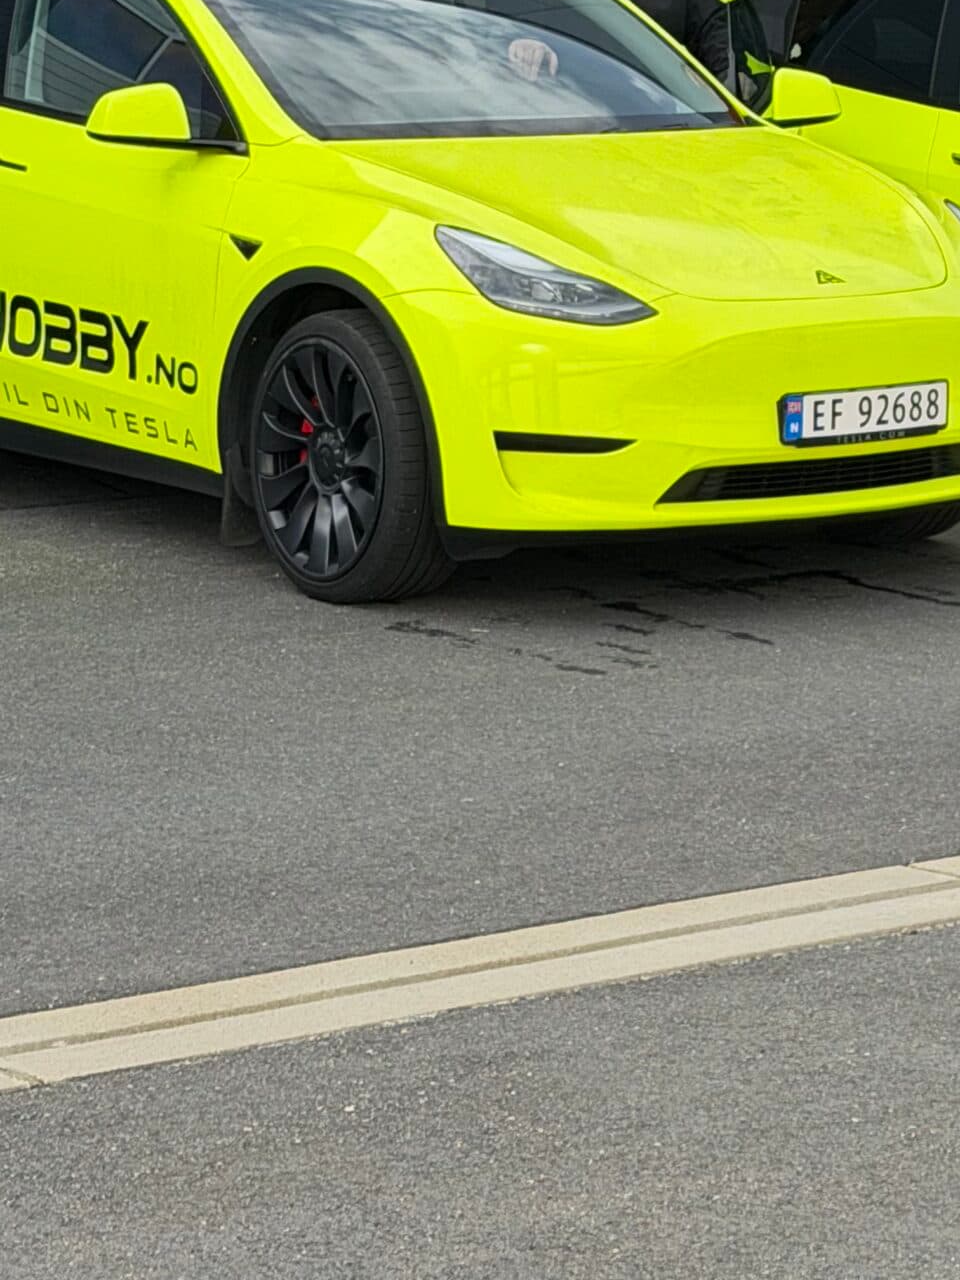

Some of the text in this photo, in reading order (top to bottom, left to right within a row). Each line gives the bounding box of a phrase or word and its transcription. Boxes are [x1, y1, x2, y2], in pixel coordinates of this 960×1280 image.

[42, 391, 91, 422] DIN
[105, 406, 198, 452] TESLA
[813, 388, 940, 432] EF 92688
